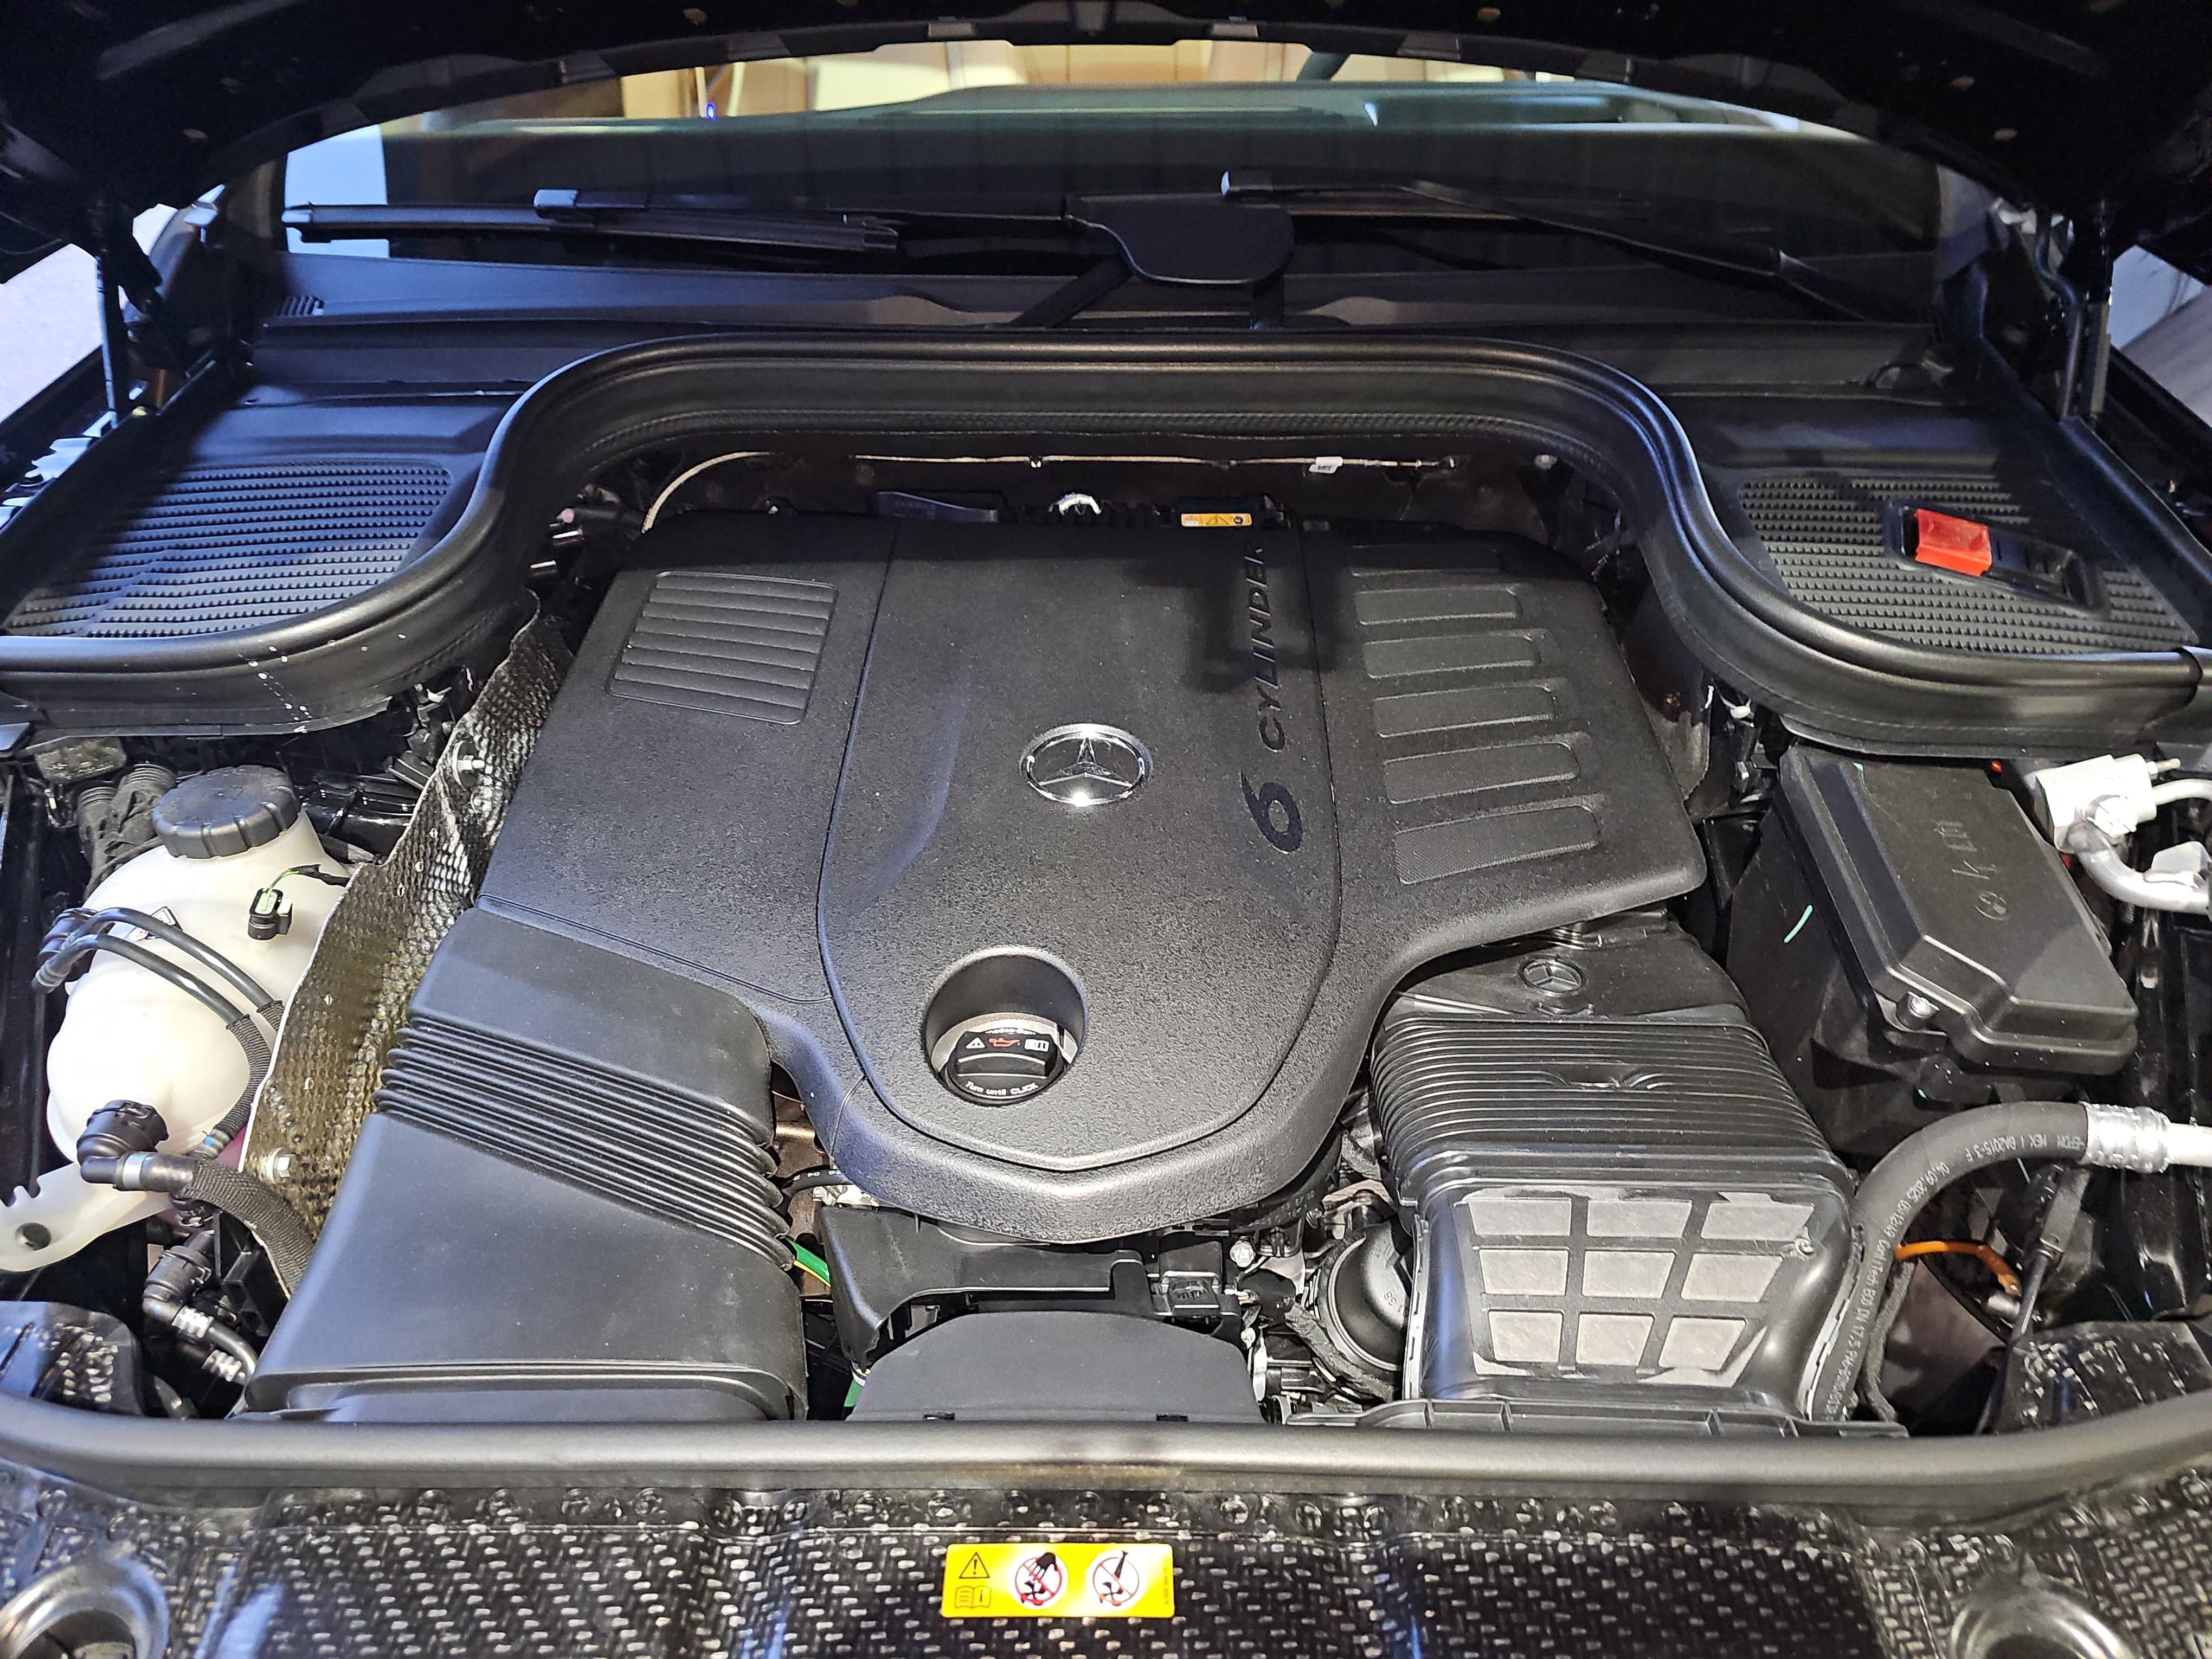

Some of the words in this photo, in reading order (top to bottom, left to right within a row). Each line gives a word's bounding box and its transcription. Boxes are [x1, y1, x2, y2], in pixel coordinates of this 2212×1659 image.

[1243, 543, 1286, 753] CYLINDER
[1239, 768, 1303, 854] 6
[964, 1081, 984, 1093] Turn
[1010, 1082, 1039, 1095] CLICK
